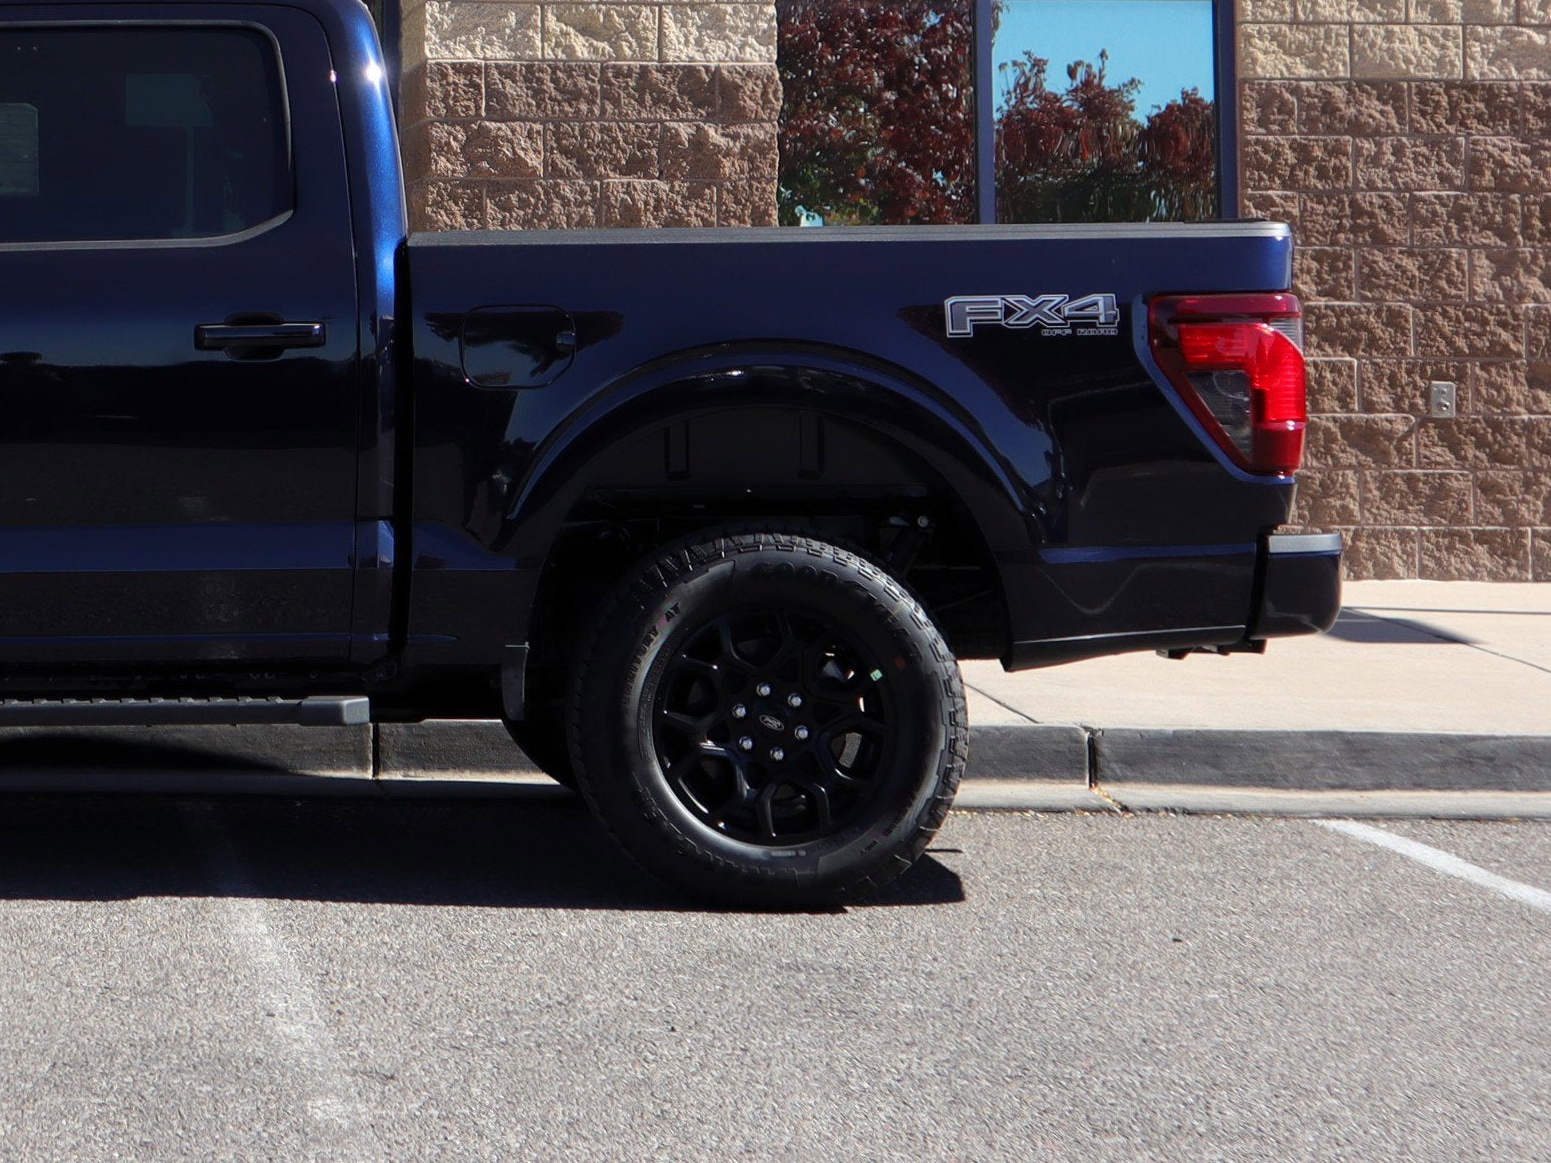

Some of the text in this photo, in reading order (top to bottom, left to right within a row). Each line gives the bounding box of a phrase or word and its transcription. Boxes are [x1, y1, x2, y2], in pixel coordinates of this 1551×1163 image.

[944, 293, 1121, 338] FX4
[1041, 328, 1119, 337] OFF ROAD
